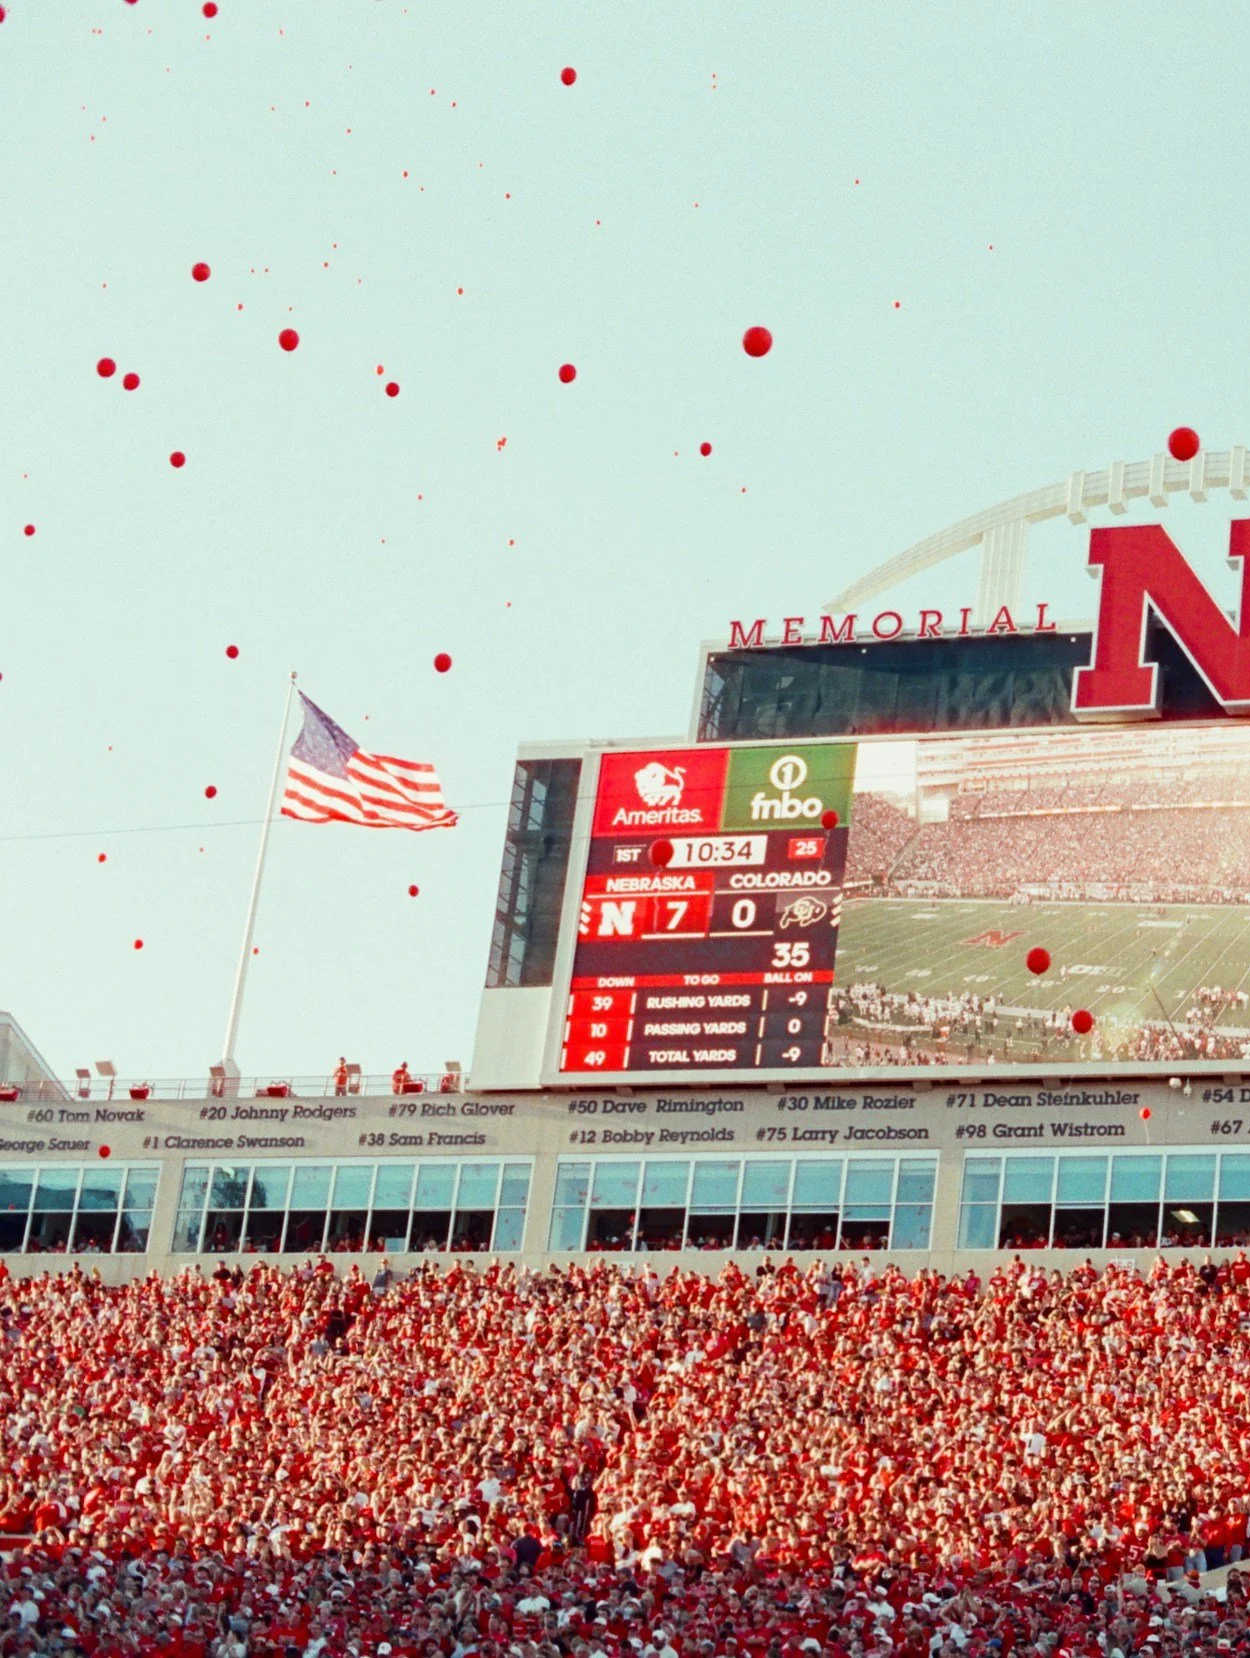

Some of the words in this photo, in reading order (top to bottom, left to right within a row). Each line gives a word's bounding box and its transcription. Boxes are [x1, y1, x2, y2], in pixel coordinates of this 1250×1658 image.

[728, 603, 1057, 650] MEMORIAL
[750, 792, 822, 819] fnbo
[612, 807, 701, 826] Ameritas
[615, 848, 641, 863] 1ST
[686, 840, 753, 862] 10:34
[794, 841, 818, 856] 25
[606, 876, 697, 893] NEBRASKA
[730, 870, 831, 888] COLORADO
[597, 901, 637, 936] N
[666, 901, 689, 930] 7
[732, 899, 756, 928] 0
[771, 942, 810, 968] 35
[597, 976, 635, 988] DOWN
[683, 974, 703, 985] TO
[703, 974, 720, 985] GO
[763, 972, 791, 984] BALL
[793, 971, 813, 983] ON
[591, 995, 613, 1011] 39
[646, 995, 705, 1009] RUSHING
[706, 993, 751, 1008] YARDS
[787, 991, 807, 1006] -9
[590, 1023, 608, 1038] 10
[644, 1022, 701, 1036] PASSING
[702, 1020, 747, 1035] YARDS
[787, 1018, 801, 1034] 0
[584, 1051, 606, 1066] 49
[649, 1049, 690, 1063] TOTAL
[691, 1048, 737, 1062] YARDS
[781, 1046, 801, 1062] -9
[777, 1096, 808, 1110] #30
[813, 1095, 857, 1110] Mike
[862, 1094, 917, 1109] Rozier
[946, 1093, 976, 1108] #71
[983, 1092, 1026, 1107] Dean
[1037, 1090, 1139, 1106] Steinkuhler
[1202, 1088, 1234, 1103] #54
[27, 1109, 53, 1122] #60
[58, 1109, 90, 1122] Tom
[94, 1108, 145, 1122] Novak
[200, 1106, 226, 1120] #20
[231, 1106, 289, 1122] Johnny
[292, 1103, 357, 1121] Rodgers
[388, 1103, 417, 1118] #79
[420, 1102, 456, 1117] Rich
[461, 1102, 515, 1116] Glover
[568, 1100, 598, 1114] #50
[601, 1099, 647, 1114] Dave
[655, 1098, 745, 1116] Rimington
[756, 1127, 787, 1141] #75
[791, 1126, 839, 1144] Larry
[844, 1126, 929, 1141] Jacobson
[955, 1125, 987, 1139] #98
[992, 1123, 1044, 1138] Grant
[1050, 1122, 1126, 1137] Wistrom
[1210, 1120, 1243, 1135] #67
[48, 1138, 91, 1150] Sauer
[143, 1136, 159, 1149] #1
[165, 1136, 233, 1149] Clarence
[237, 1134, 305, 1148] Swanson
[358, 1132, 385, 1146] #38
[389, 1132, 423, 1146] Sam
[427, 1131, 486, 1146] Francis
[569, 1130, 596, 1144] #12
[601, 1129, 655, 1145] Bobby
[658, 1128, 735, 1144] Reynolds
